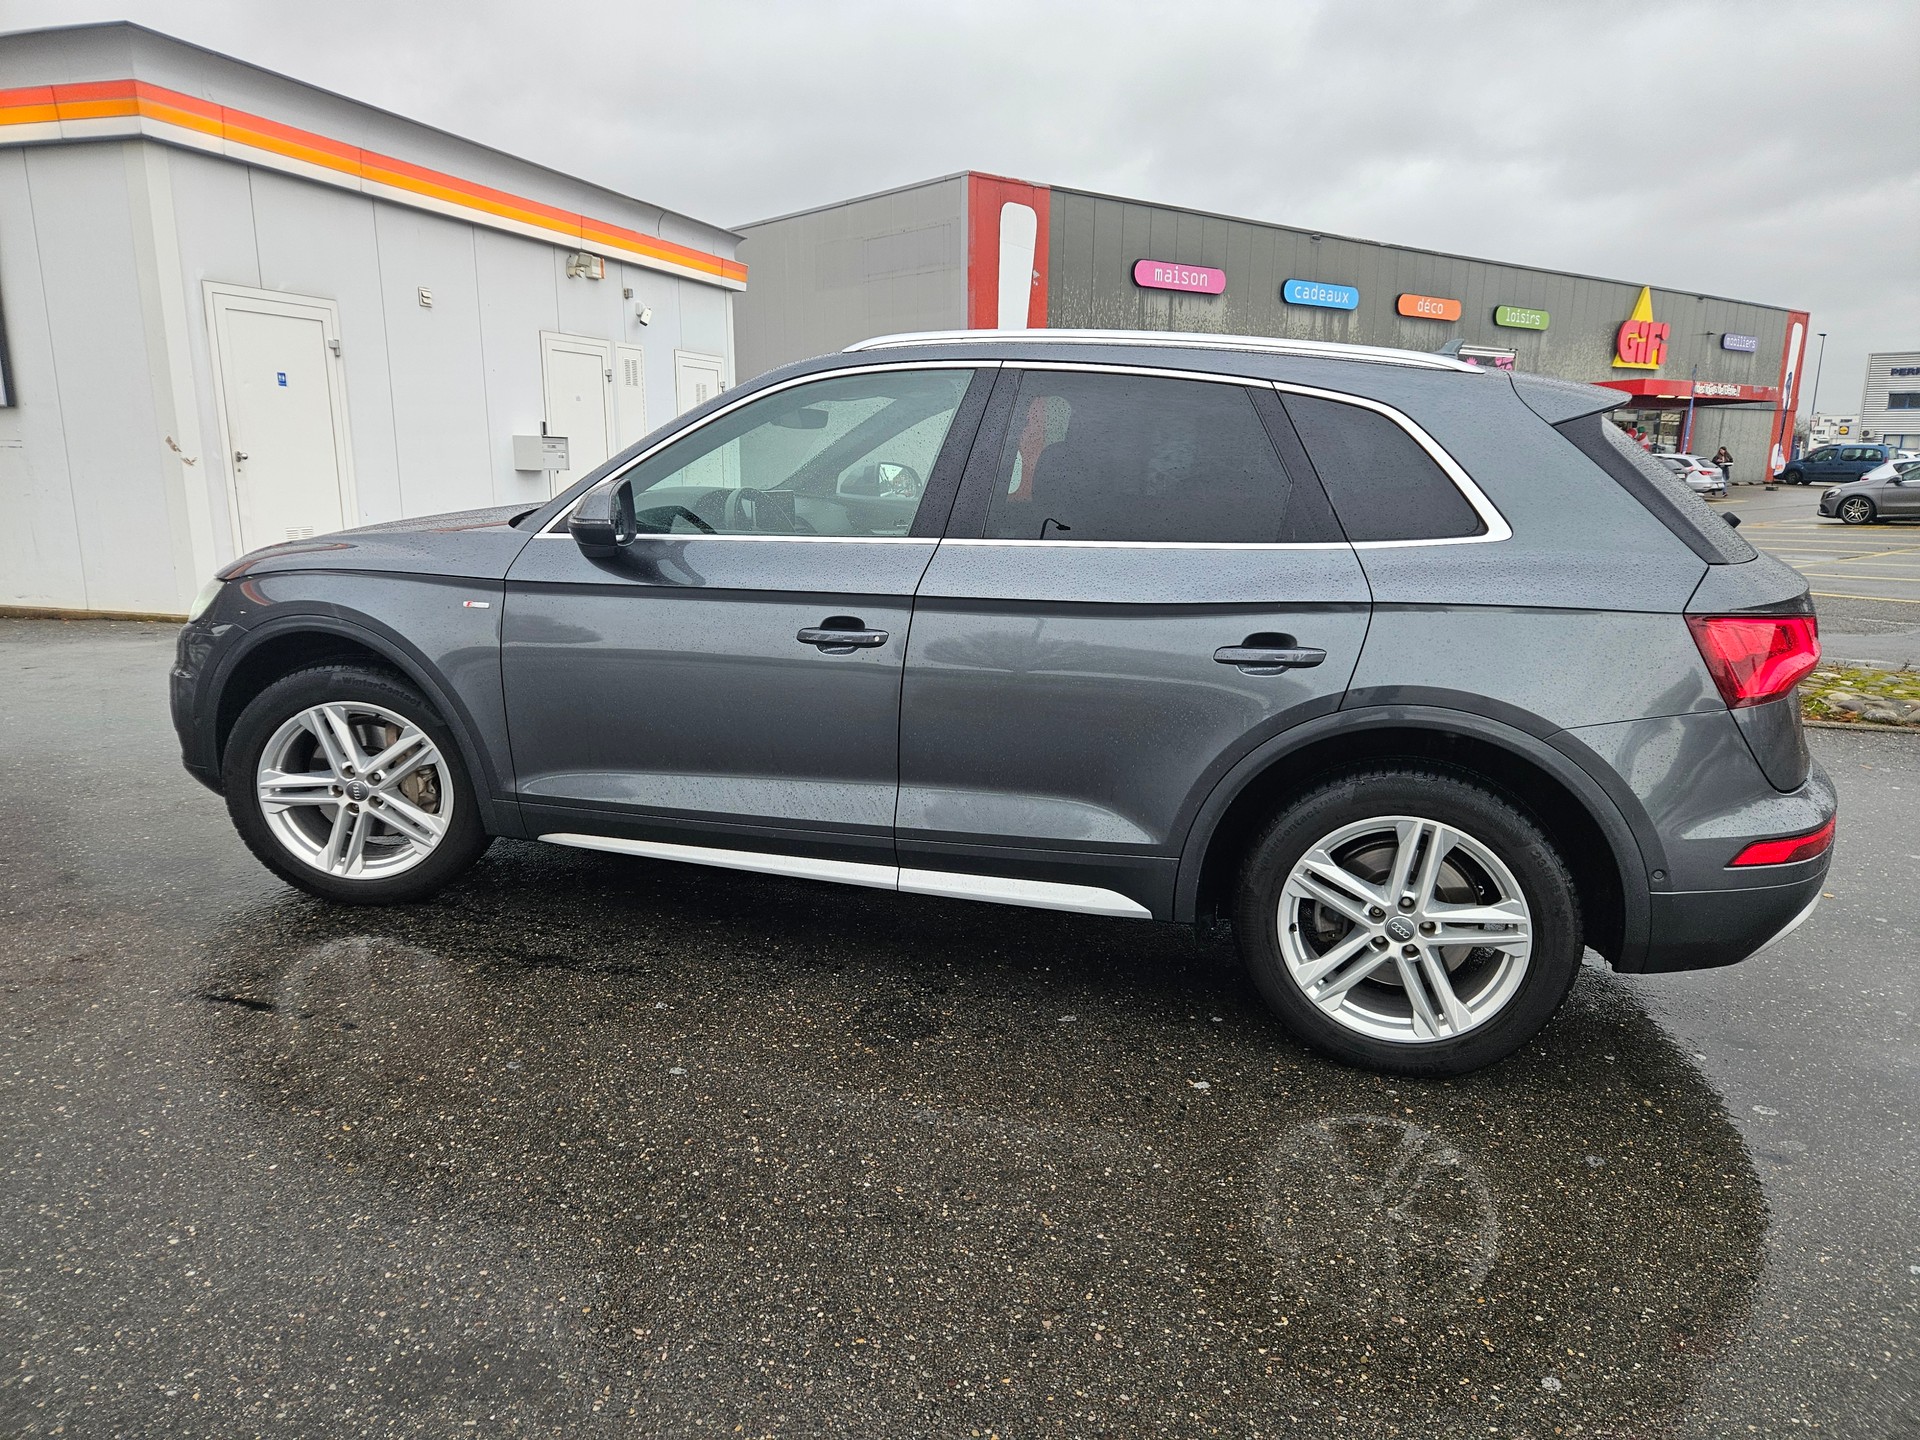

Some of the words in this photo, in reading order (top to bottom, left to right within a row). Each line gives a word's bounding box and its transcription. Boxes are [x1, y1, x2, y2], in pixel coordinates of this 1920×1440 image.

[1154, 265, 1208, 287] maison
[1294, 285, 1350, 304] cadeaux
[1417, 298, 1444, 315] déco
[1505, 308, 1541, 325] loisirs
[1726, 336, 1756, 349] mobiliers
